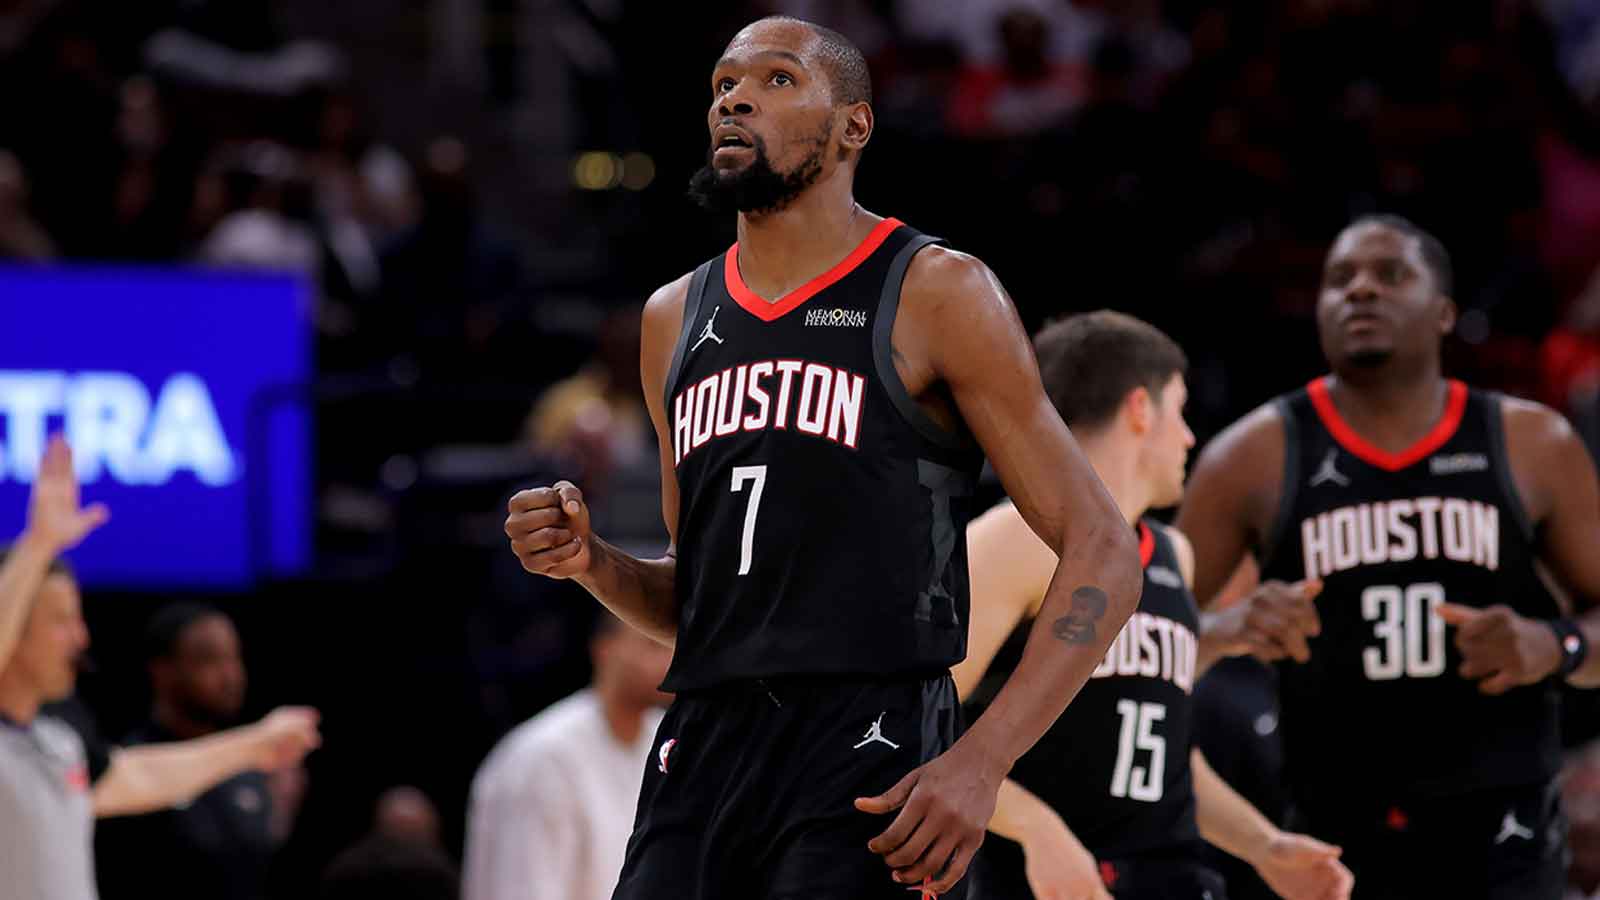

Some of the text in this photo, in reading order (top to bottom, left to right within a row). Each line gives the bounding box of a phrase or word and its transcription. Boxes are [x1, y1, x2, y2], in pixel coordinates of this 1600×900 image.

[805, 316, 866, 327] HERMANN
[806, 308, 867, 321] MEMORIAL
[0, 369, 239, 487] TRA
[674, 359, 866, 468] HOUSTON
[730, 465, 768, 576] 7
[1301, 496, 1499, 580] HOUSTON
[1361, 582, 1446, 681] 30
[1110, 699, 1167, 802] 15
